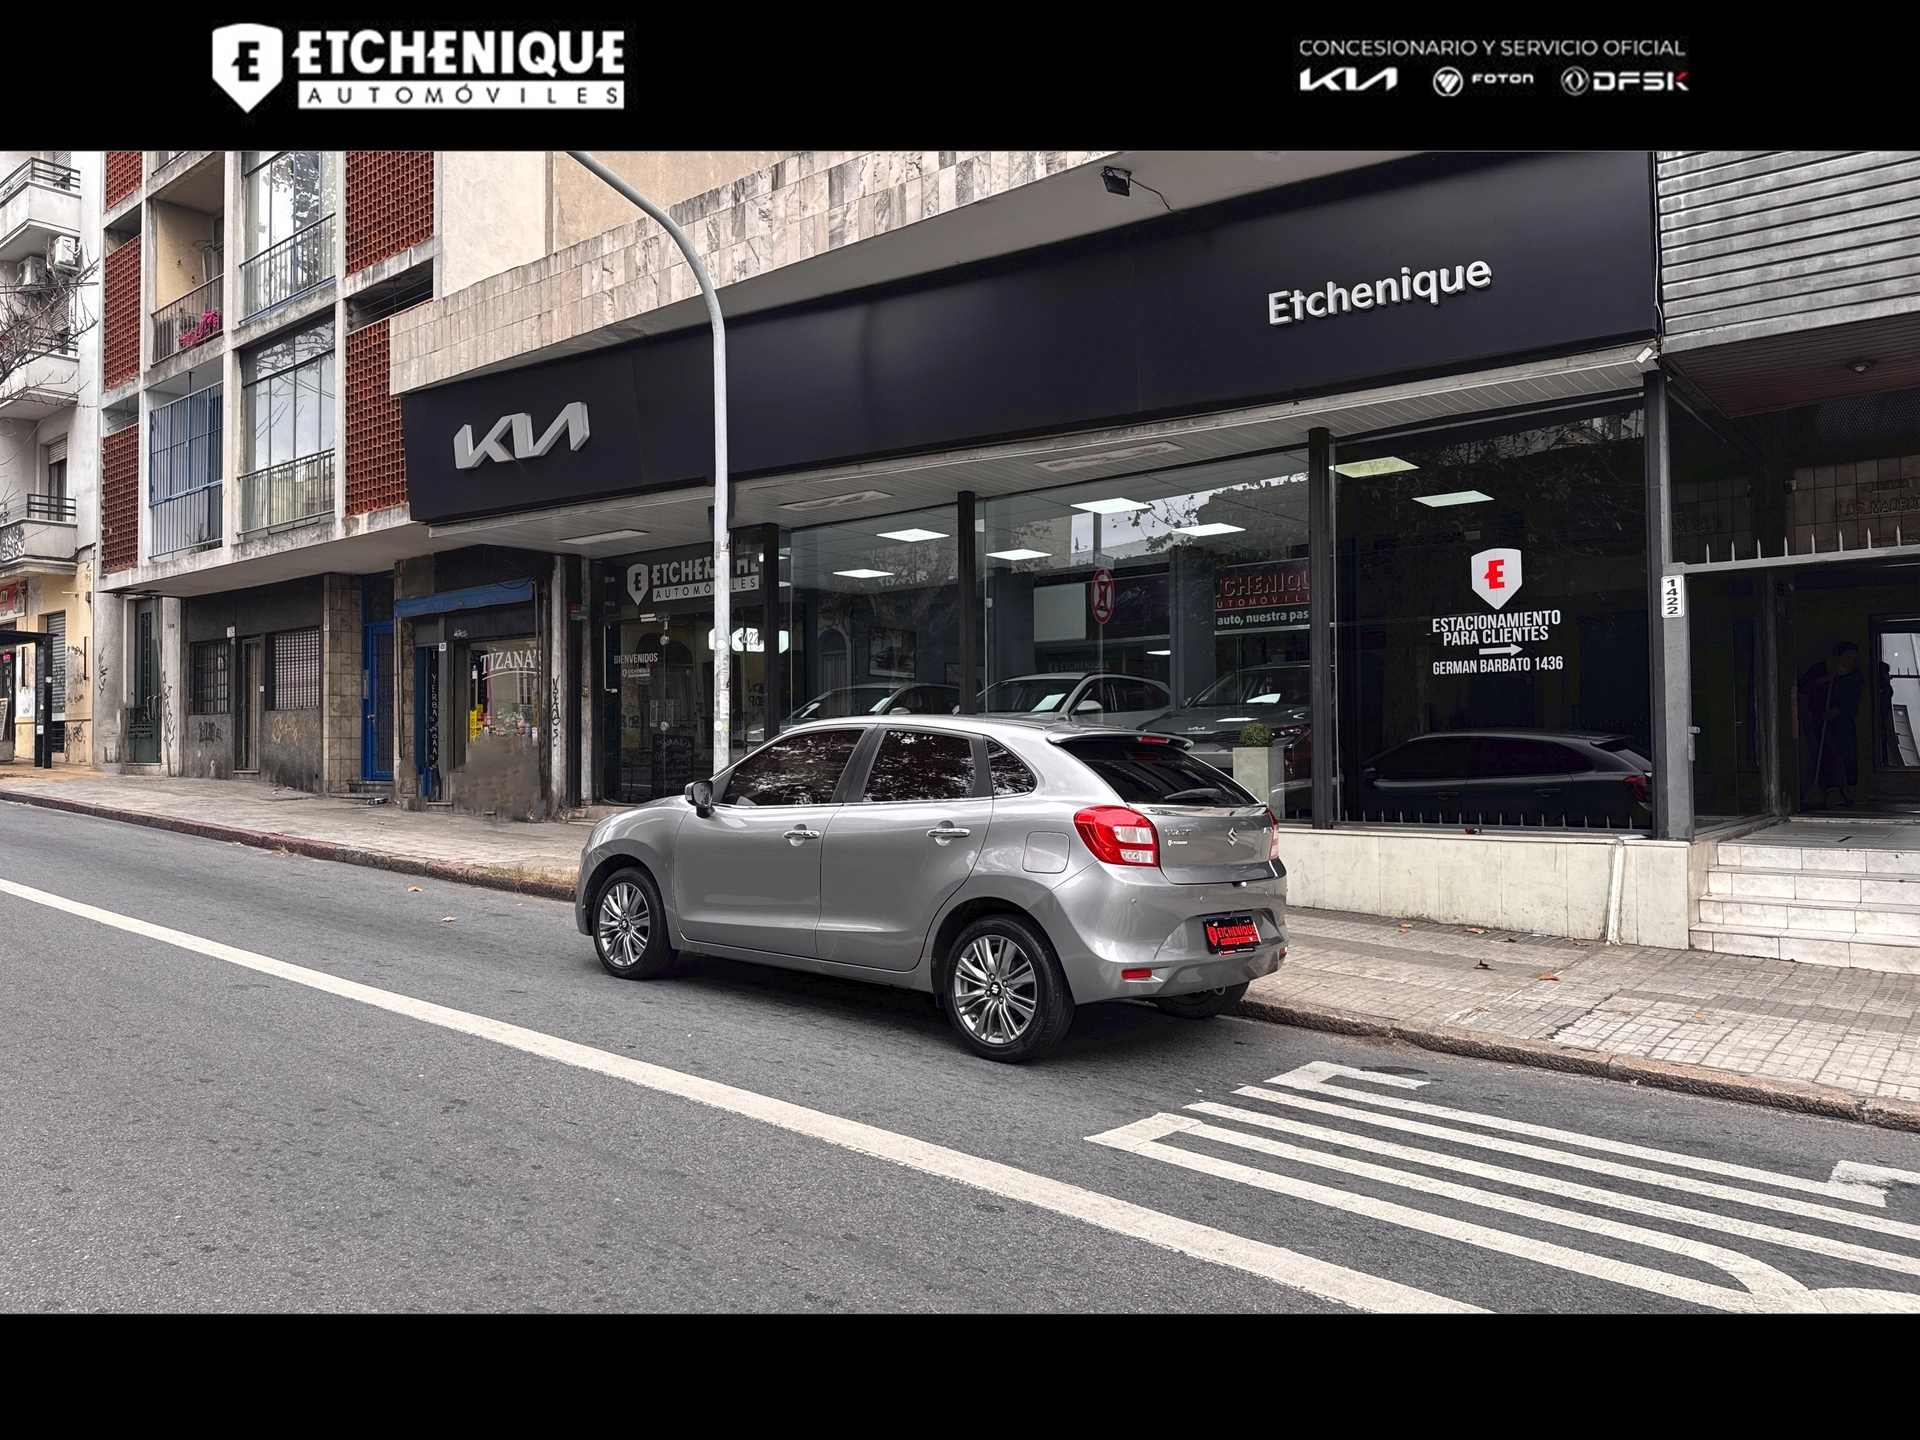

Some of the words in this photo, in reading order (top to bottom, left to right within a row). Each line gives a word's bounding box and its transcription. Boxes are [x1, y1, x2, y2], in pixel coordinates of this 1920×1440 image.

[1268, 260, 1492, 325] Etchenique
[453, 401, 590, 470] KIA
[655, 578, 756, 599] AUTOMÓLES
[1666, 579, 1678, 615] 1422
[1217, 615, 1244, 625] auto,
[1246, 612, 1286, 623] nuestra
[1432, 609, 1561, 633] ESTACIONAMIENTO
[1443, 630, 1479, 646] PARA
[1482, 625, 1549, 645] CLIENTES
[613, 652, 658, 664] BIENVENIDOS
[1432, 659, 1477, 675] GERMAN
[1479, 657, 1531, 673] BARBATO
[1534, 655, 1563, 671] 1436
